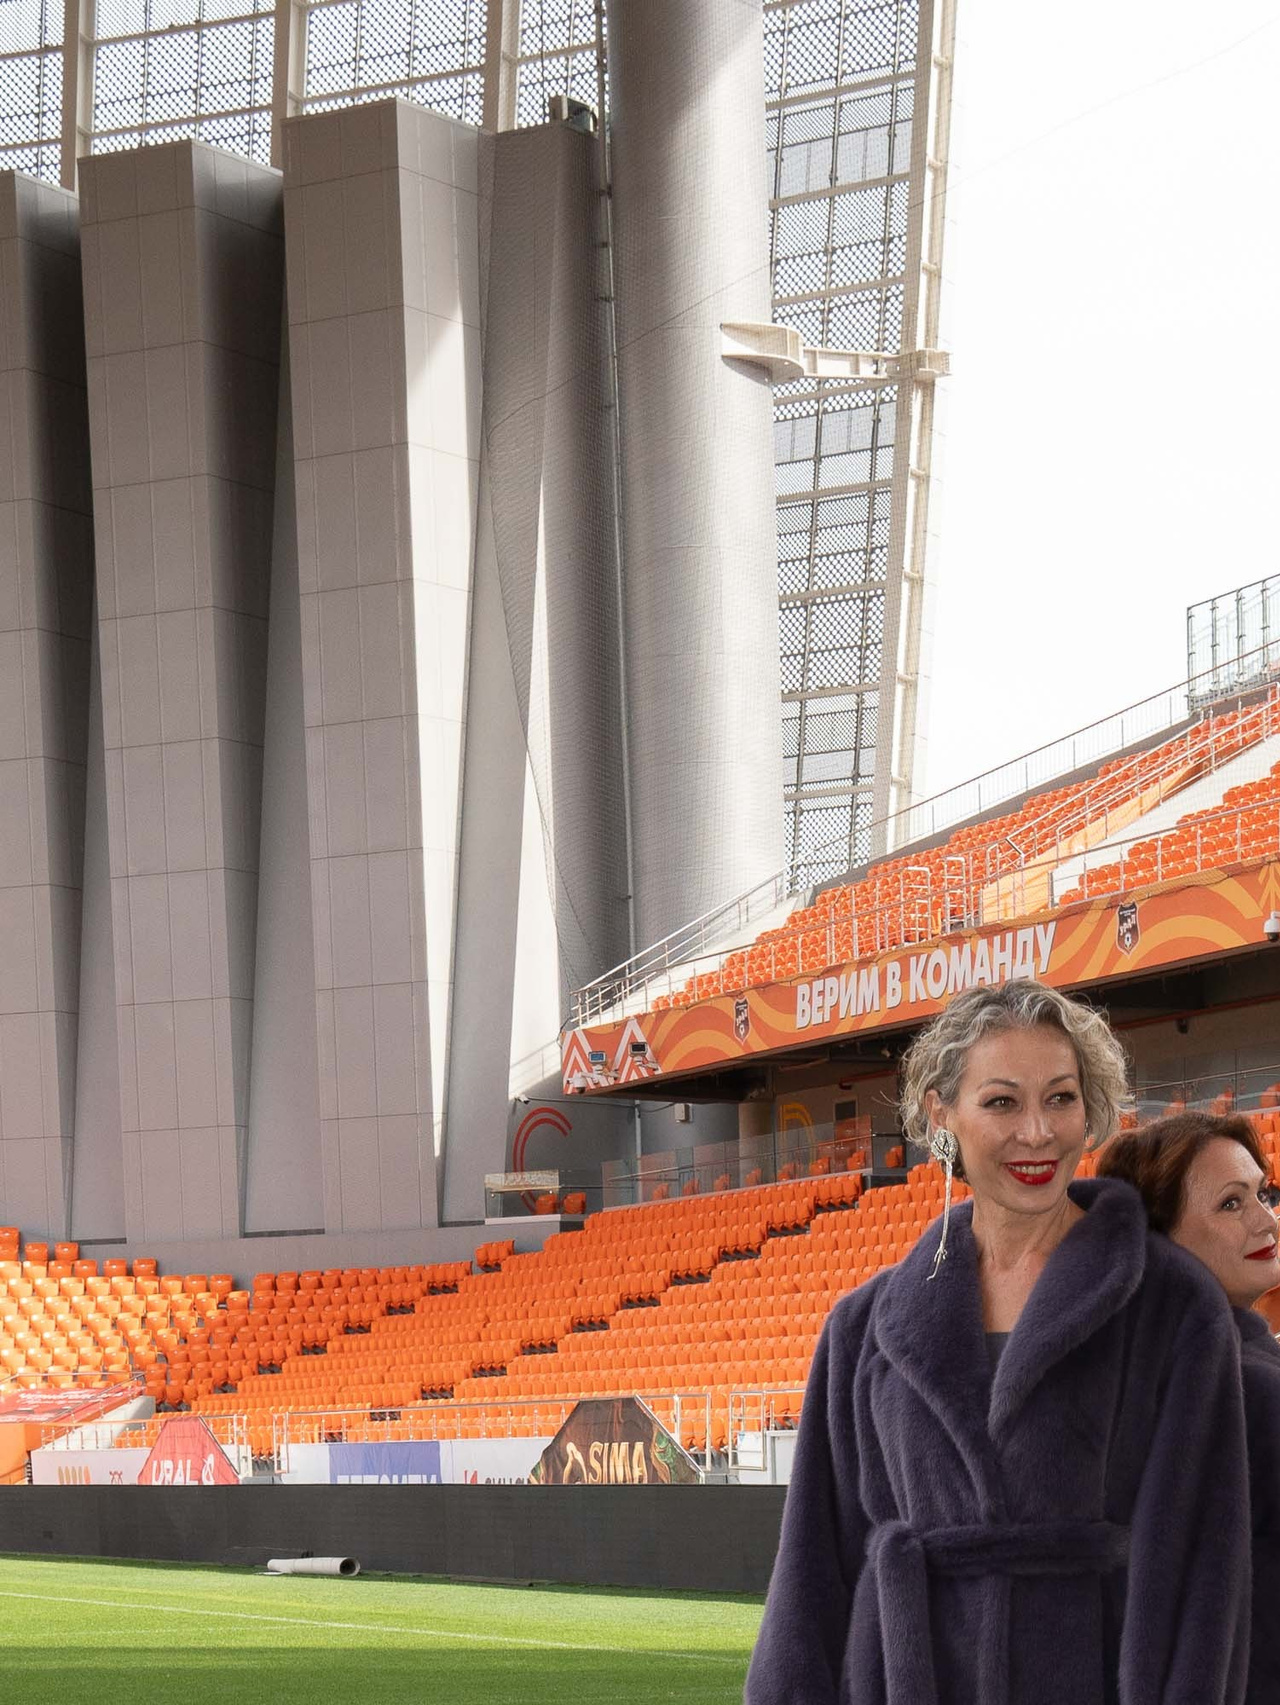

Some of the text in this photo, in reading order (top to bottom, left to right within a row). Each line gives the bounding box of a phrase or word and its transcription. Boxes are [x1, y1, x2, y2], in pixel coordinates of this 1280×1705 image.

[795, 921, 1057, 1029] ВЕРИМ В КОМАНДУ
[151, 1459, 199, 1485] URAL
[588, 1441, 648, 1484] SIMA
